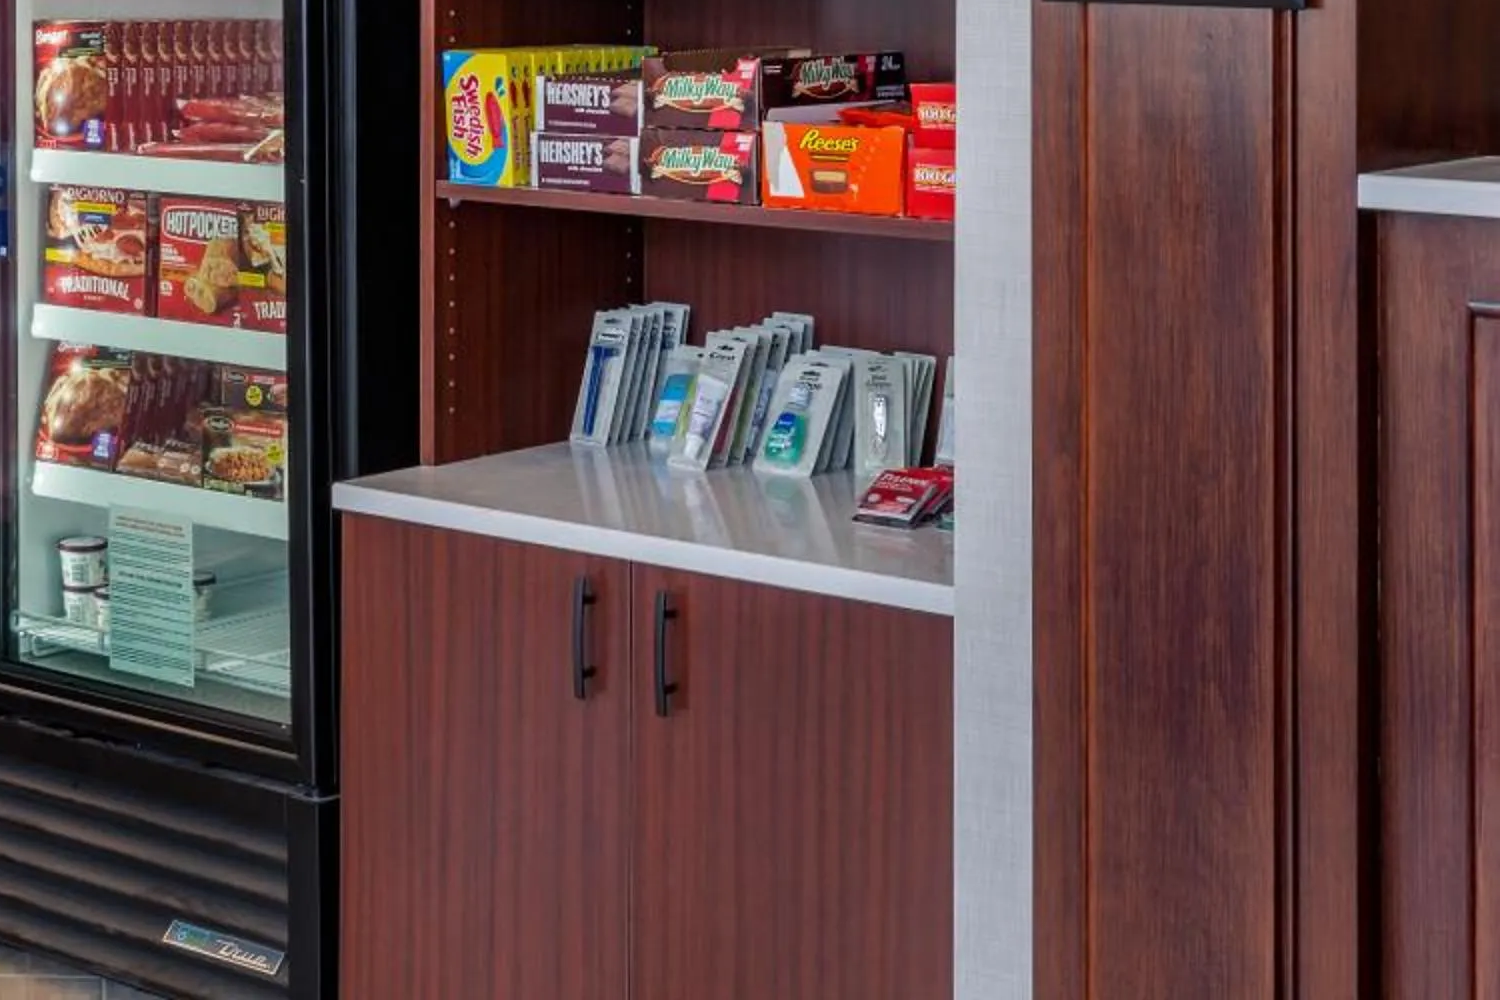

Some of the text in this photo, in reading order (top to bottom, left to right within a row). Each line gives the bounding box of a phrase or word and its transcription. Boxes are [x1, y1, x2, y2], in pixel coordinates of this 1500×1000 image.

[546, 81, 611, 108] HERSHEY'S
[452, 95, 469, 140] Fish
[460, 73, 485, 158] Swedish
[539, 140, 603, 166] HERSHEY'S
[166, 211, 189, 236] HOT
[60, 275, 130, 301] TRADITIONAL
